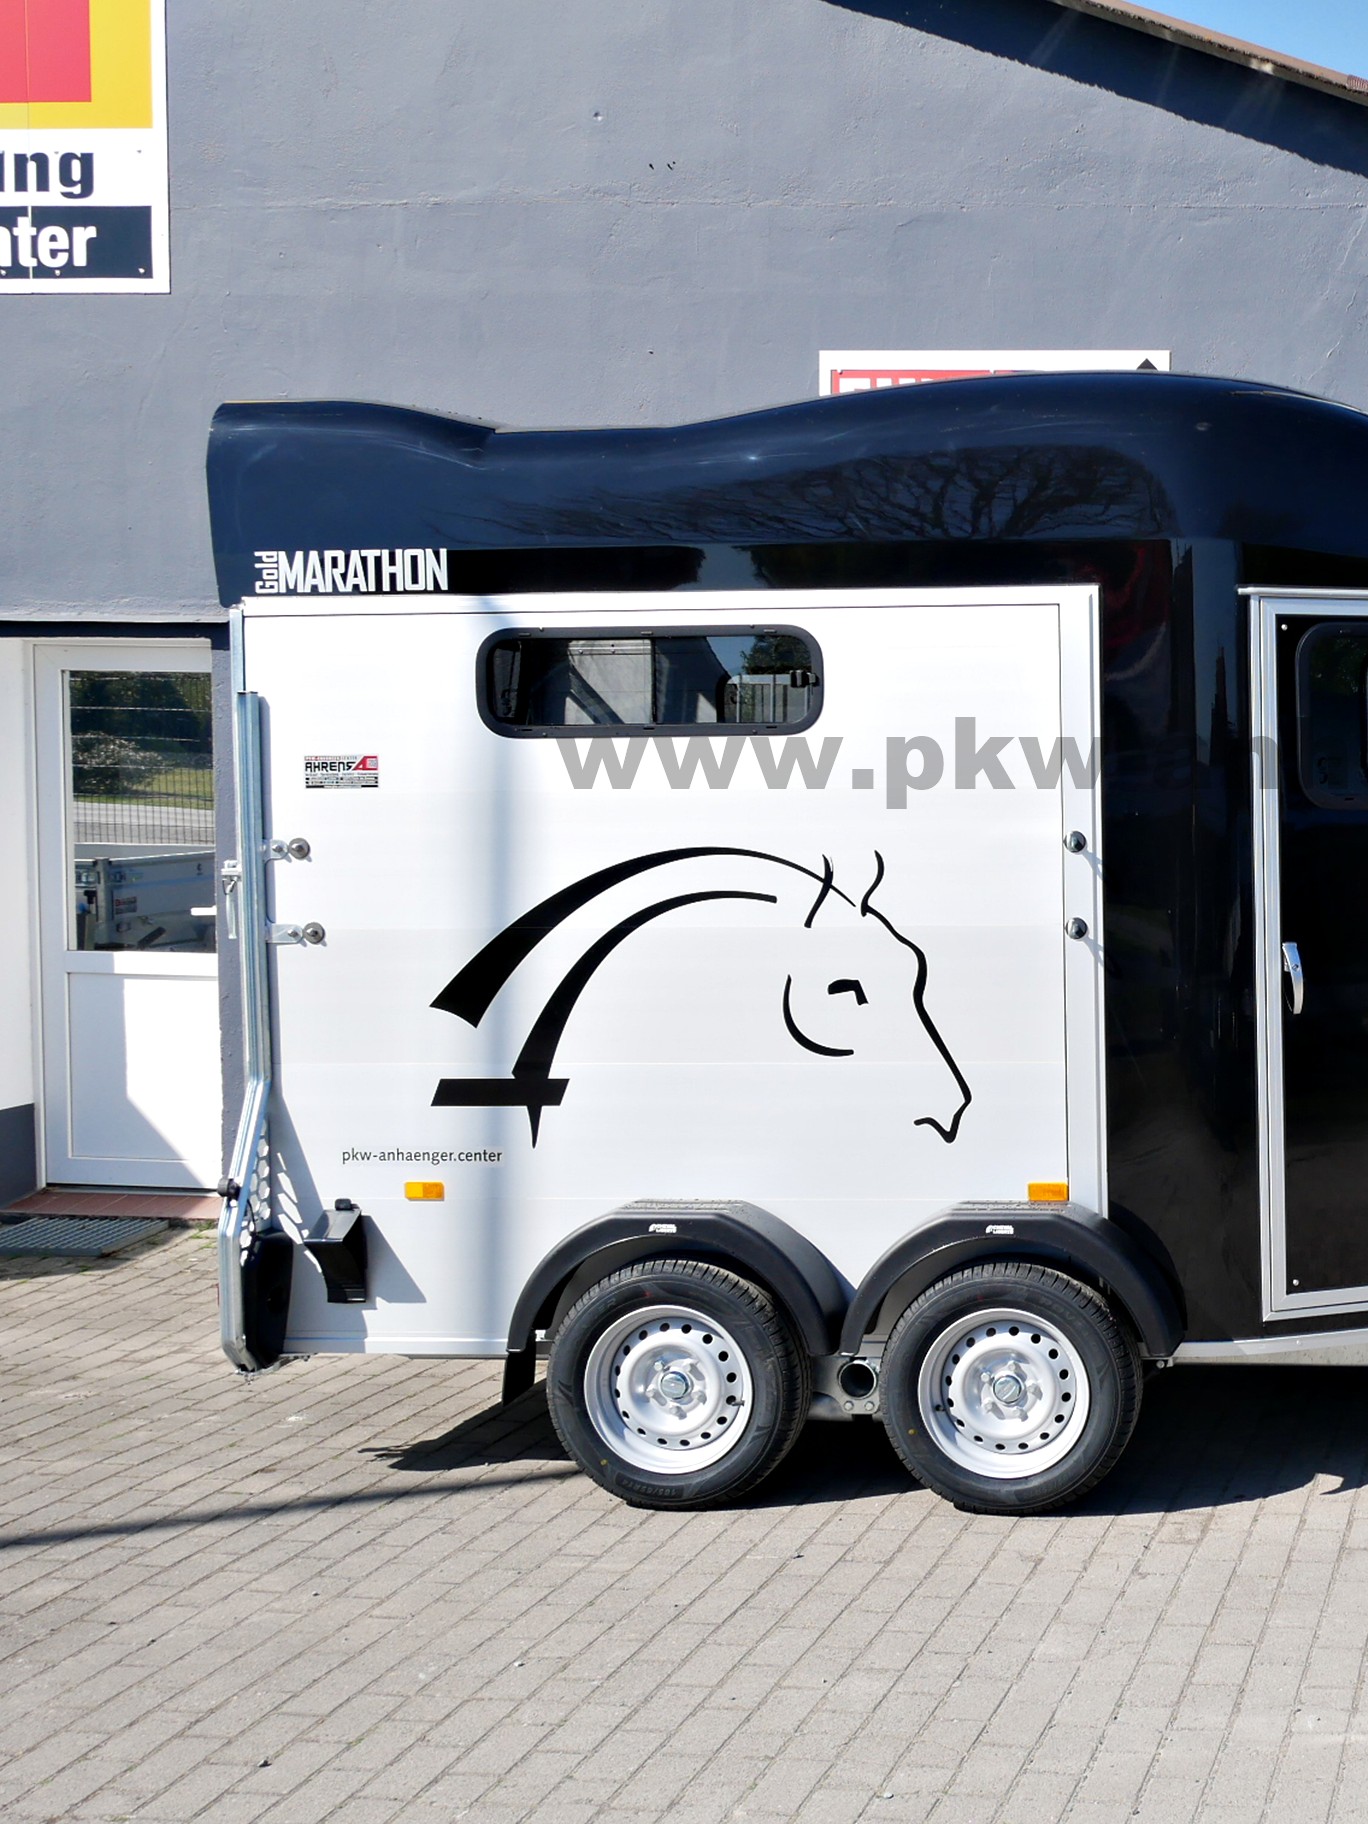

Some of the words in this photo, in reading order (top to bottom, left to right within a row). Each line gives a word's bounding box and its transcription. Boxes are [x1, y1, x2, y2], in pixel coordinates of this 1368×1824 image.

[254, 551, 279, 594] Gold
[279, 548, 449, 593] MARATHON
[305, 761, 357, 773] AHRENS
[341, 1147, 503, 1166] pkw-anhaenger.center
